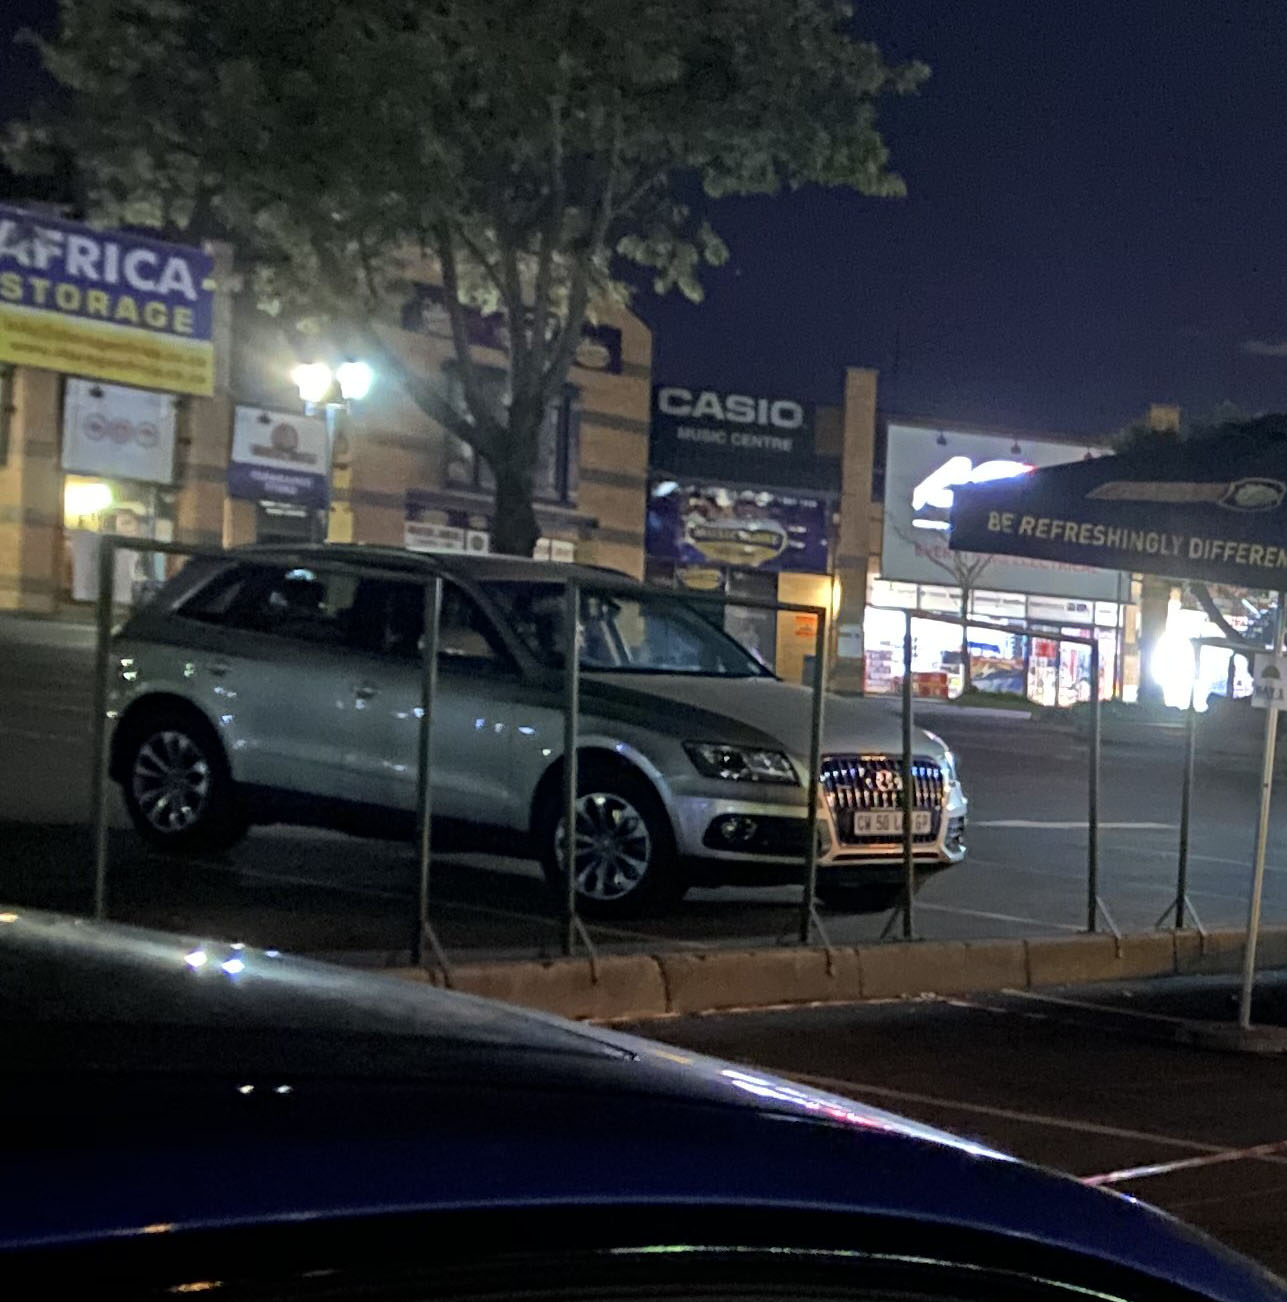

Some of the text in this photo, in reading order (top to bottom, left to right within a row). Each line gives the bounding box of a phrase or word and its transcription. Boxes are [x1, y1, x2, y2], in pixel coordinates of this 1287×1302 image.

[0, 218, 198, 302] AFRICA
[0, 271, 194, 335] STORAGE
[657, 387, 804, 430] CASIO
[730, 431, 794, 453] CENTRE
[987, 510, 1014, 534] BE
[1018, 515, 1184, 557] REFRESHINGLY
